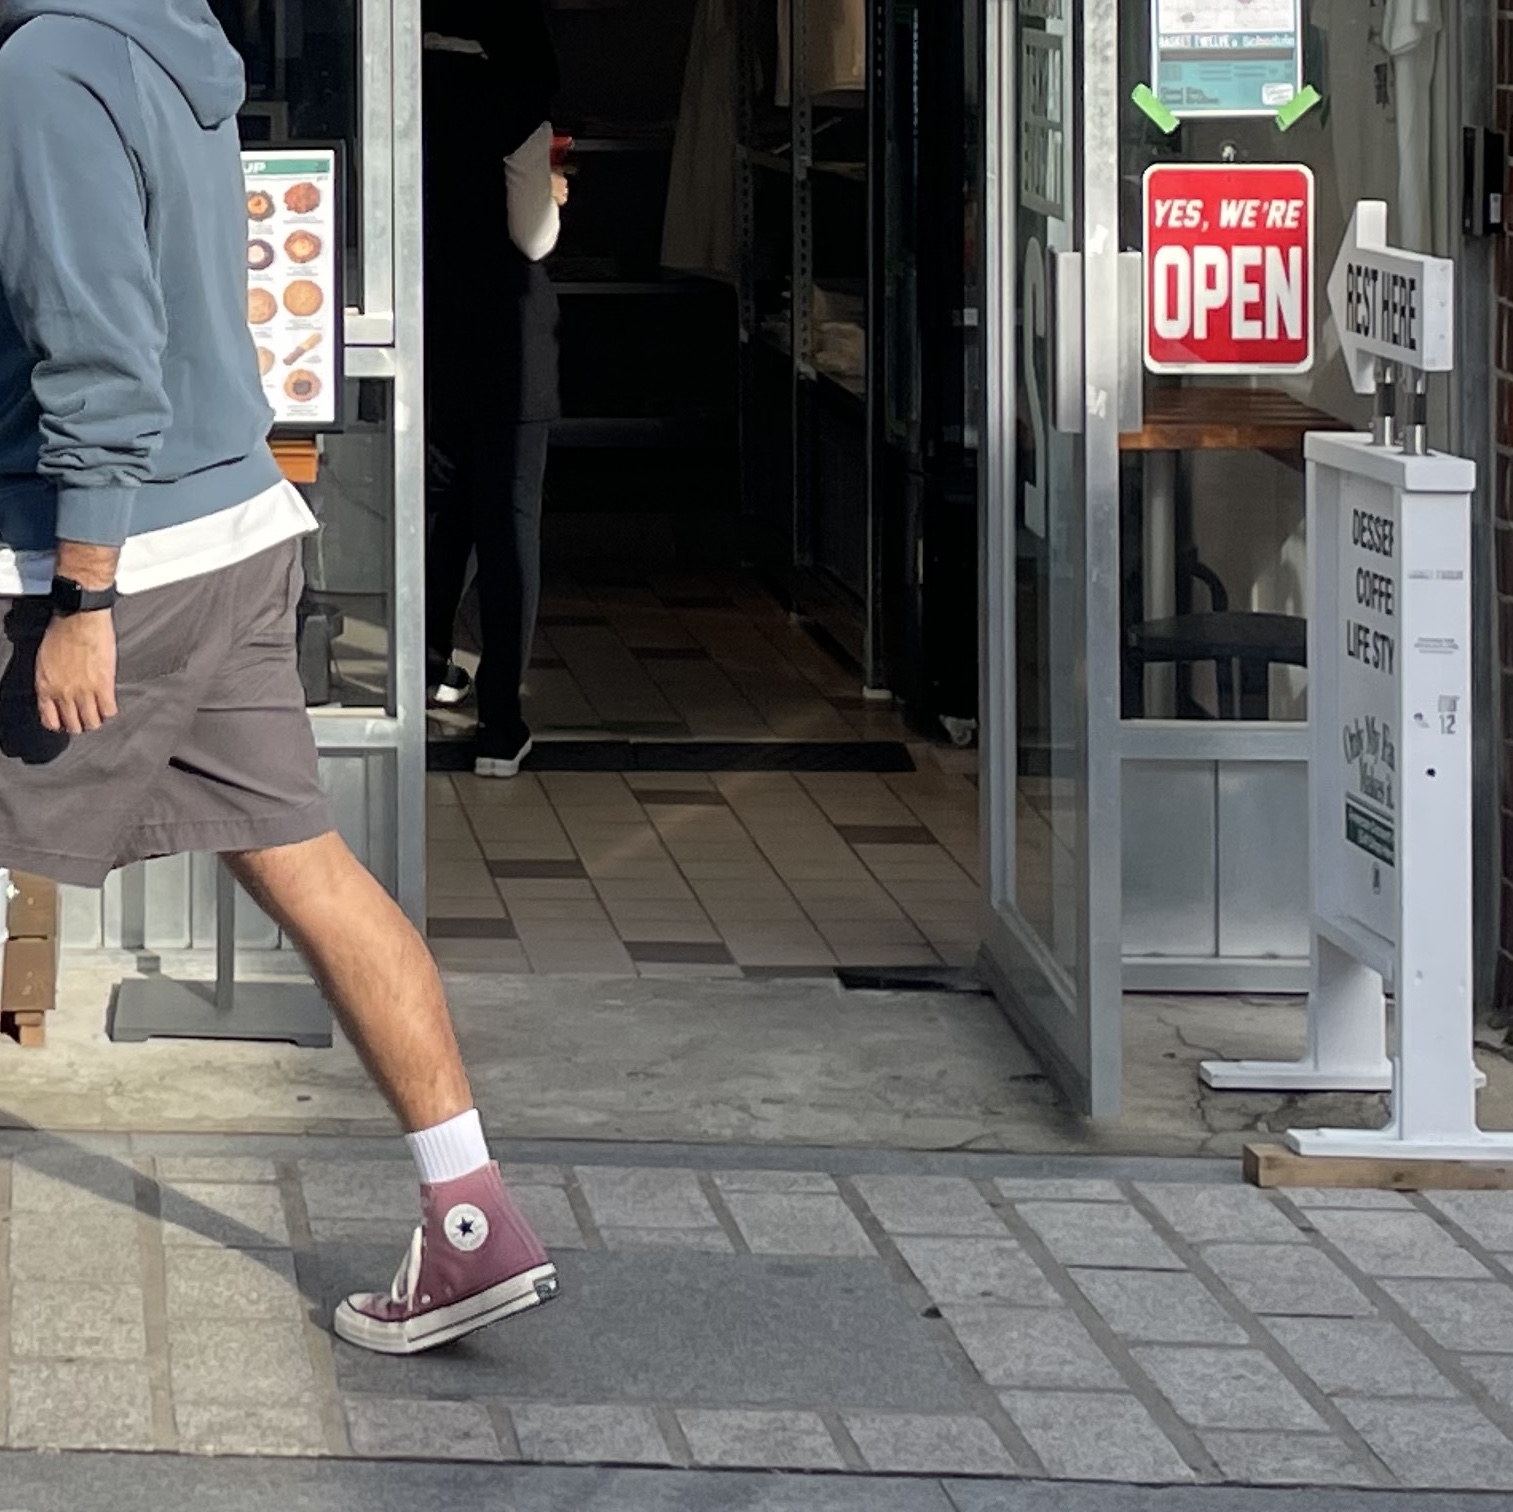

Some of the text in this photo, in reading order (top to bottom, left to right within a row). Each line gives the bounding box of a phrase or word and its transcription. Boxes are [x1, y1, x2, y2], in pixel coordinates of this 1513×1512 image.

[1153, 198, 1304, 233] YES, WE'RE
[1153, 245, 1303, 341] OPEN
[1346, 262, 1417, 352] REST HERE
[1356, 566, 1394, 616] COFFE
[1438, 713, 1457, 735] 12
